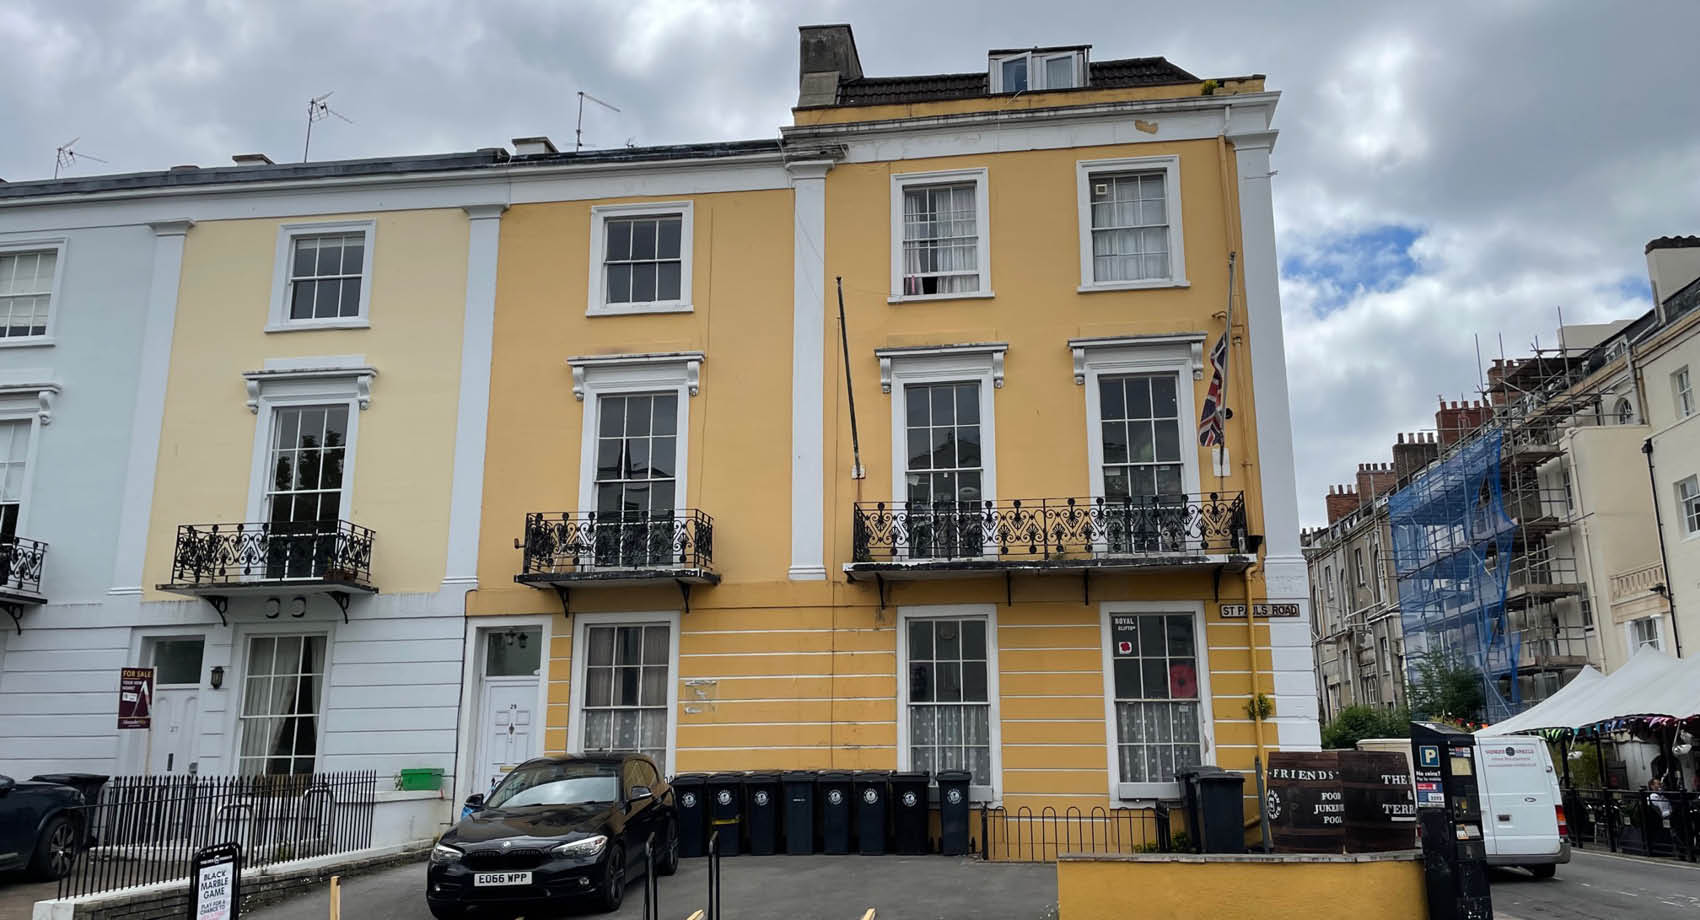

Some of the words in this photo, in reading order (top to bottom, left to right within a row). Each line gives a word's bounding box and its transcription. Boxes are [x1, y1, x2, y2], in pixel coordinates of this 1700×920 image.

[1223, 606, 1234, 615] ST
[1272, 606, 1297, 615] ROAD
[1424, 749, 1436, 764] P
[1273, 768, 1334, 780] FRIENDS
[204, 870, 227, 881] BLACK
[479, 874, 505, 884] EO66
[508, 873, 527, 883] WPP
[201, 877, 228, 891] MARBLE
[203, 887, 225, 899] GAME
